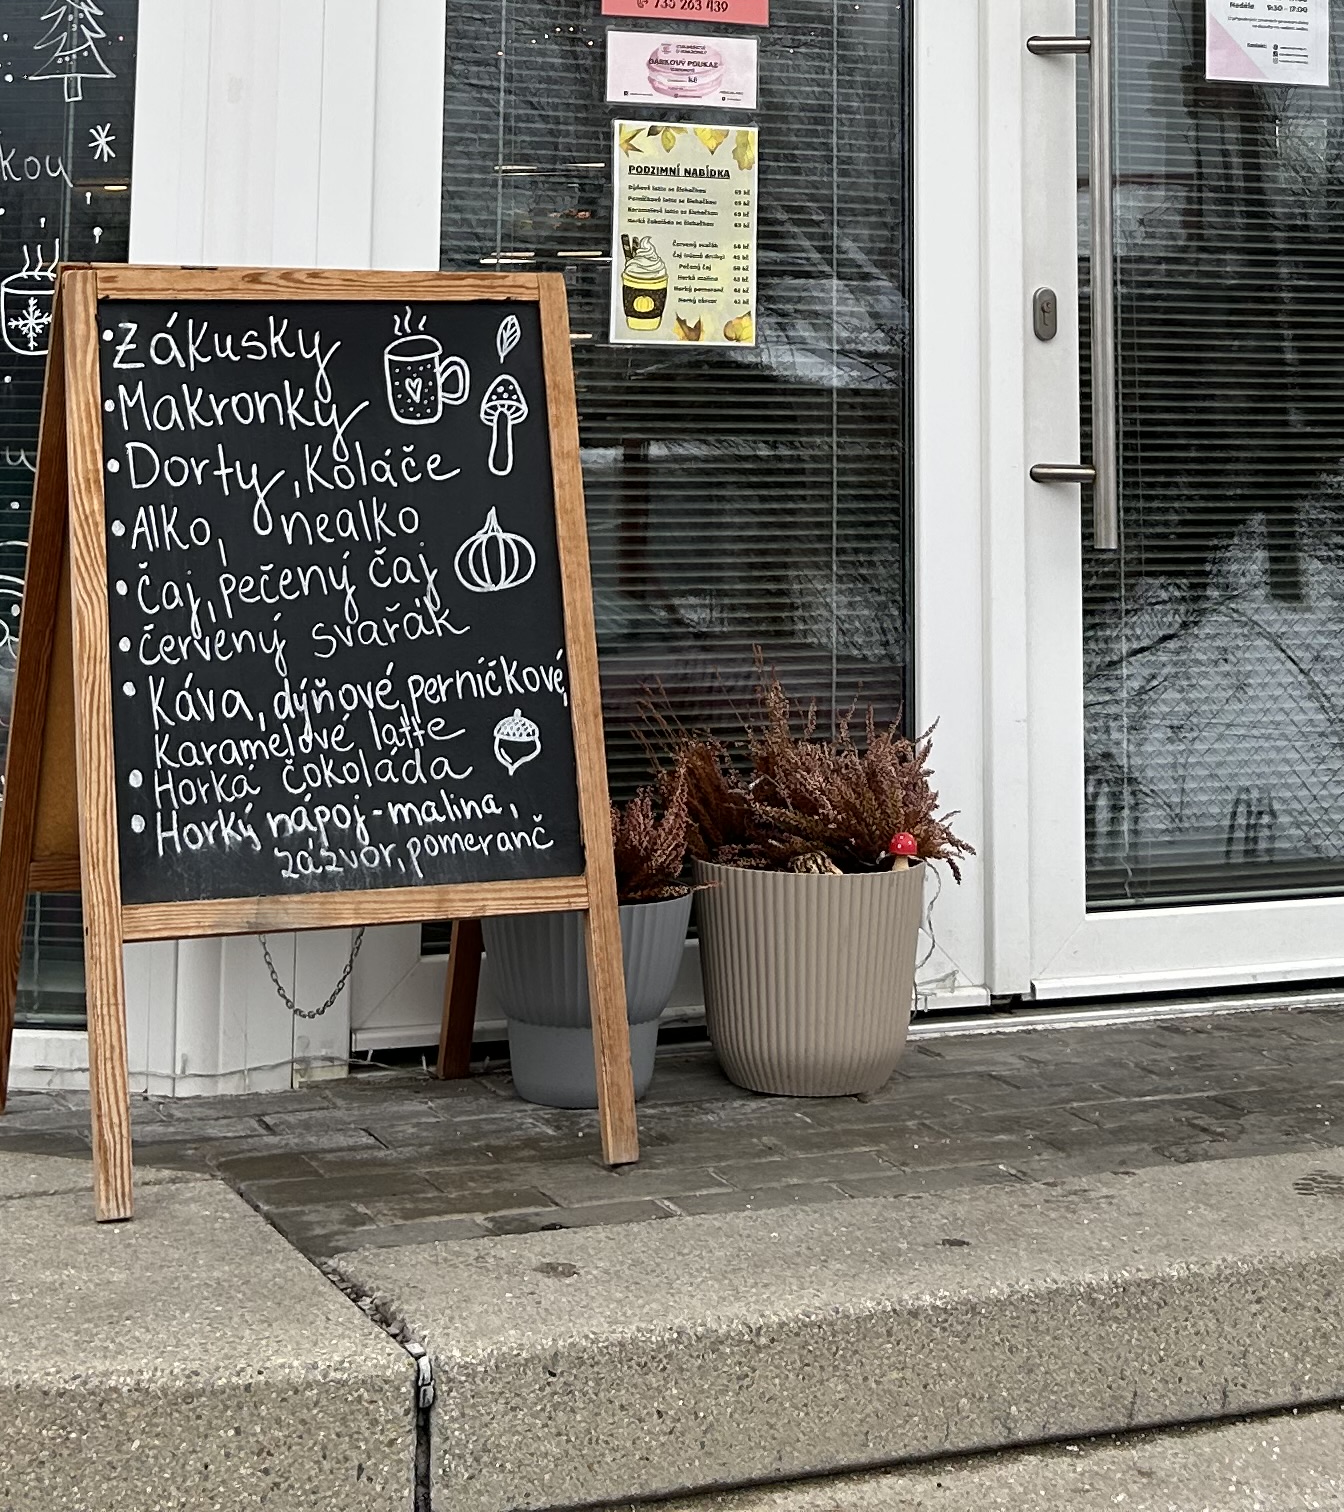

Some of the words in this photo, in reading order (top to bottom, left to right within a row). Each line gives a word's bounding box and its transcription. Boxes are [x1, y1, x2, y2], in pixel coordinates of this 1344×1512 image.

[628, 163, 680, 176] PODZIMNÍ
[684, 165, 730, 178] NABÍDKA
[112, 312, 342, 403] Zákusky
[118, 380, 370, 463] Makronky
[280, 496, 420, 545] nealko
[368, 708, 466, 751] latte
[155, 760, 261, 810] Horká
[156, 803, 262, 857] Horký
[407, 814, 555, 878] pomeranč
